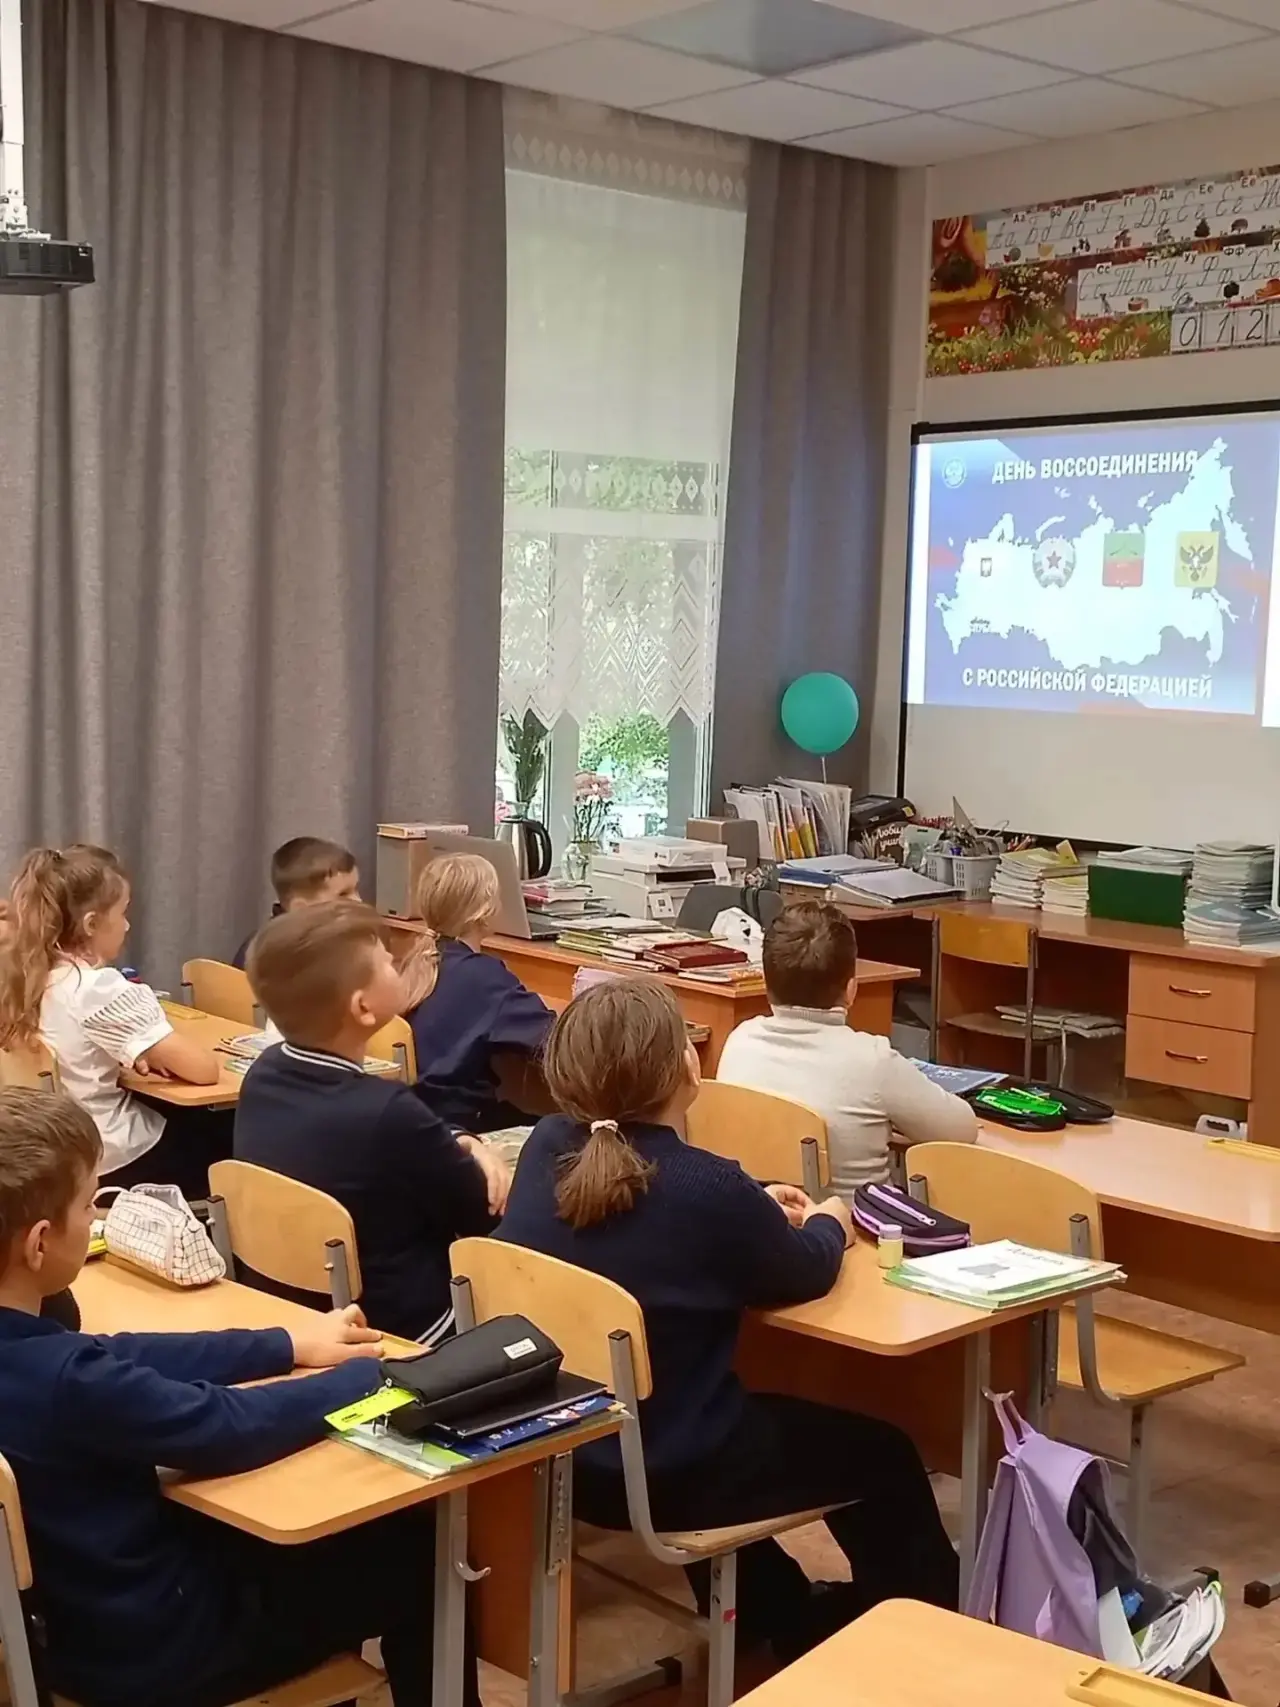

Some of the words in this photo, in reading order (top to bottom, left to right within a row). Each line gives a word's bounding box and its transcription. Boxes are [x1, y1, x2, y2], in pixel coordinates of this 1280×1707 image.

[1179, 316, 1198, 347] 0
[1216, 311, 1231, 344] 1
[1245, 308, 1264, 341] 2
[992, 460, 1036, 484] ДЕНЬ
[1041, 450, 1198, 479] ВОССОЕДИНЕНИЯ
[962, 667, 974, 686] С
[977, 666, 1086, 692] РОССИЙСКОЙ
[1091, 673, 1212, 699] ФЕДЕРАЦИЕЙ
